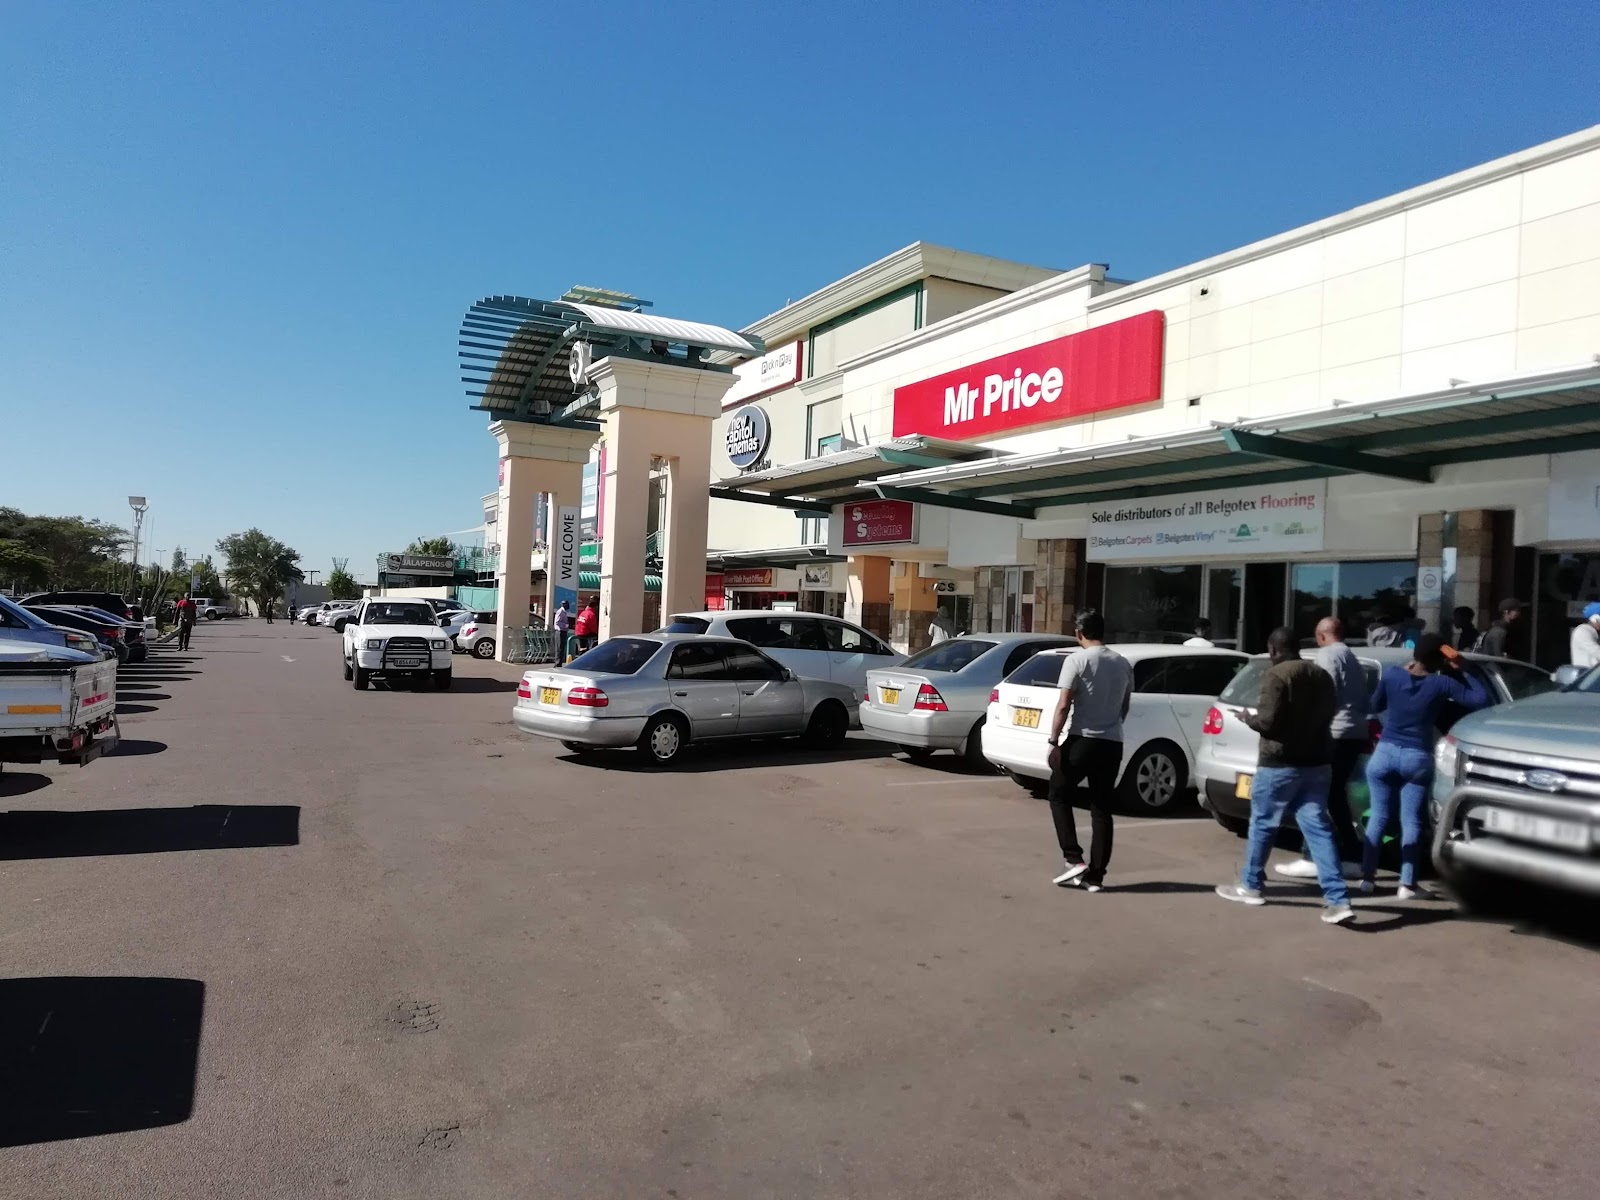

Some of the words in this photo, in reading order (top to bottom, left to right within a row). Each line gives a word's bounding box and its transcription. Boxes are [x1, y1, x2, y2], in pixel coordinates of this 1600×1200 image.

[779, 353, 793, 368] Pay
[944, 382, 979, 426] Mr
[983, 366, 1064, 417] Price
[726, 421, 755, 444] capitol
[731, 415, 749, 429] new
[727, 436, 758, 457] cinemas
[1092, 511, 1112, 523] Sole
[1114, 507, 1172, 522] distributors
[1174, 503, 1186, 517] of
[1188, 501, 1202, 516] all
[1206, 499, 1257, 517] Belgotex
[1260, 492, 1316, 510] Flooring
[857, 523, 903, 540] Systems
[561, 513, 575, 580] WELCOME
[743, 574, 752, 584] Post
[752, 573, 764, 583] Office
